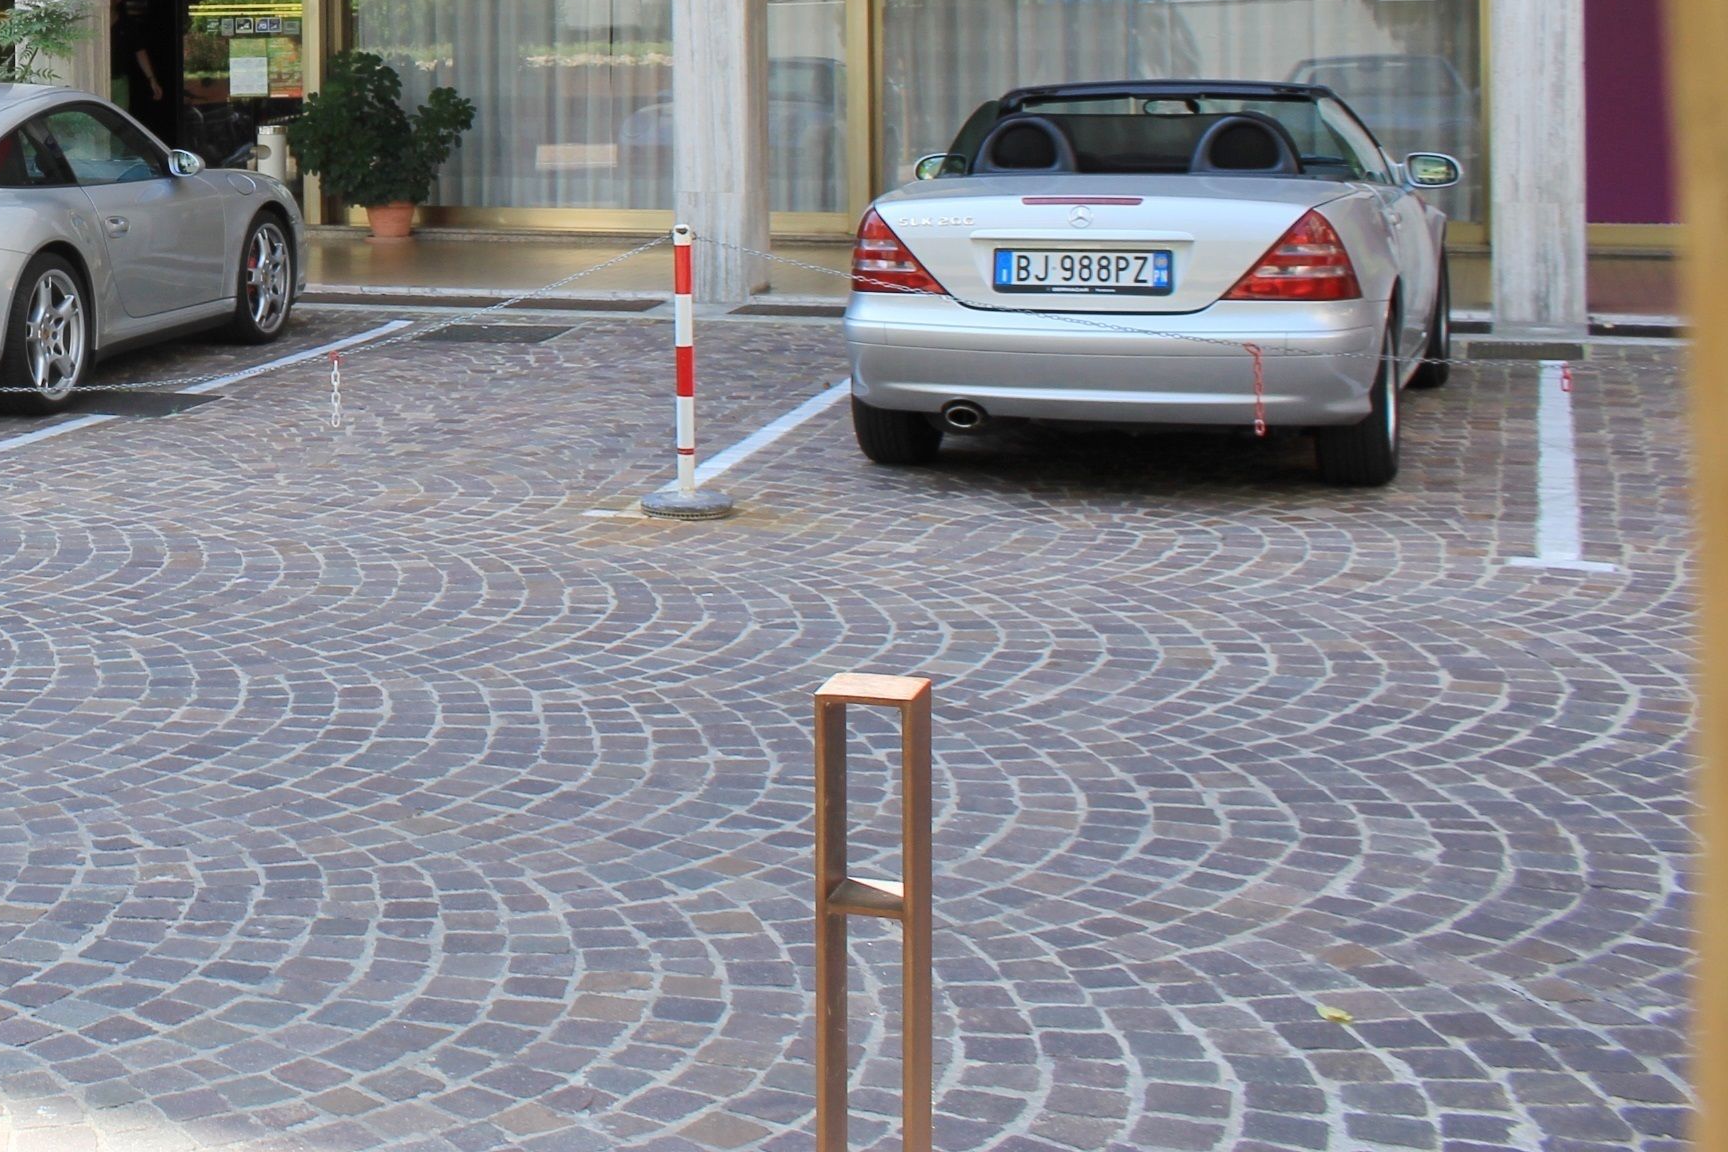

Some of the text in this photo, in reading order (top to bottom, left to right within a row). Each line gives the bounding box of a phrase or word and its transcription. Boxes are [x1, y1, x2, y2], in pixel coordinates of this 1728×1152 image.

[898, 216, 976, 227] SLK 200
[1016, 255, 1049, 282] BJ
[1060, 255, 1149, 284] 988PZ
